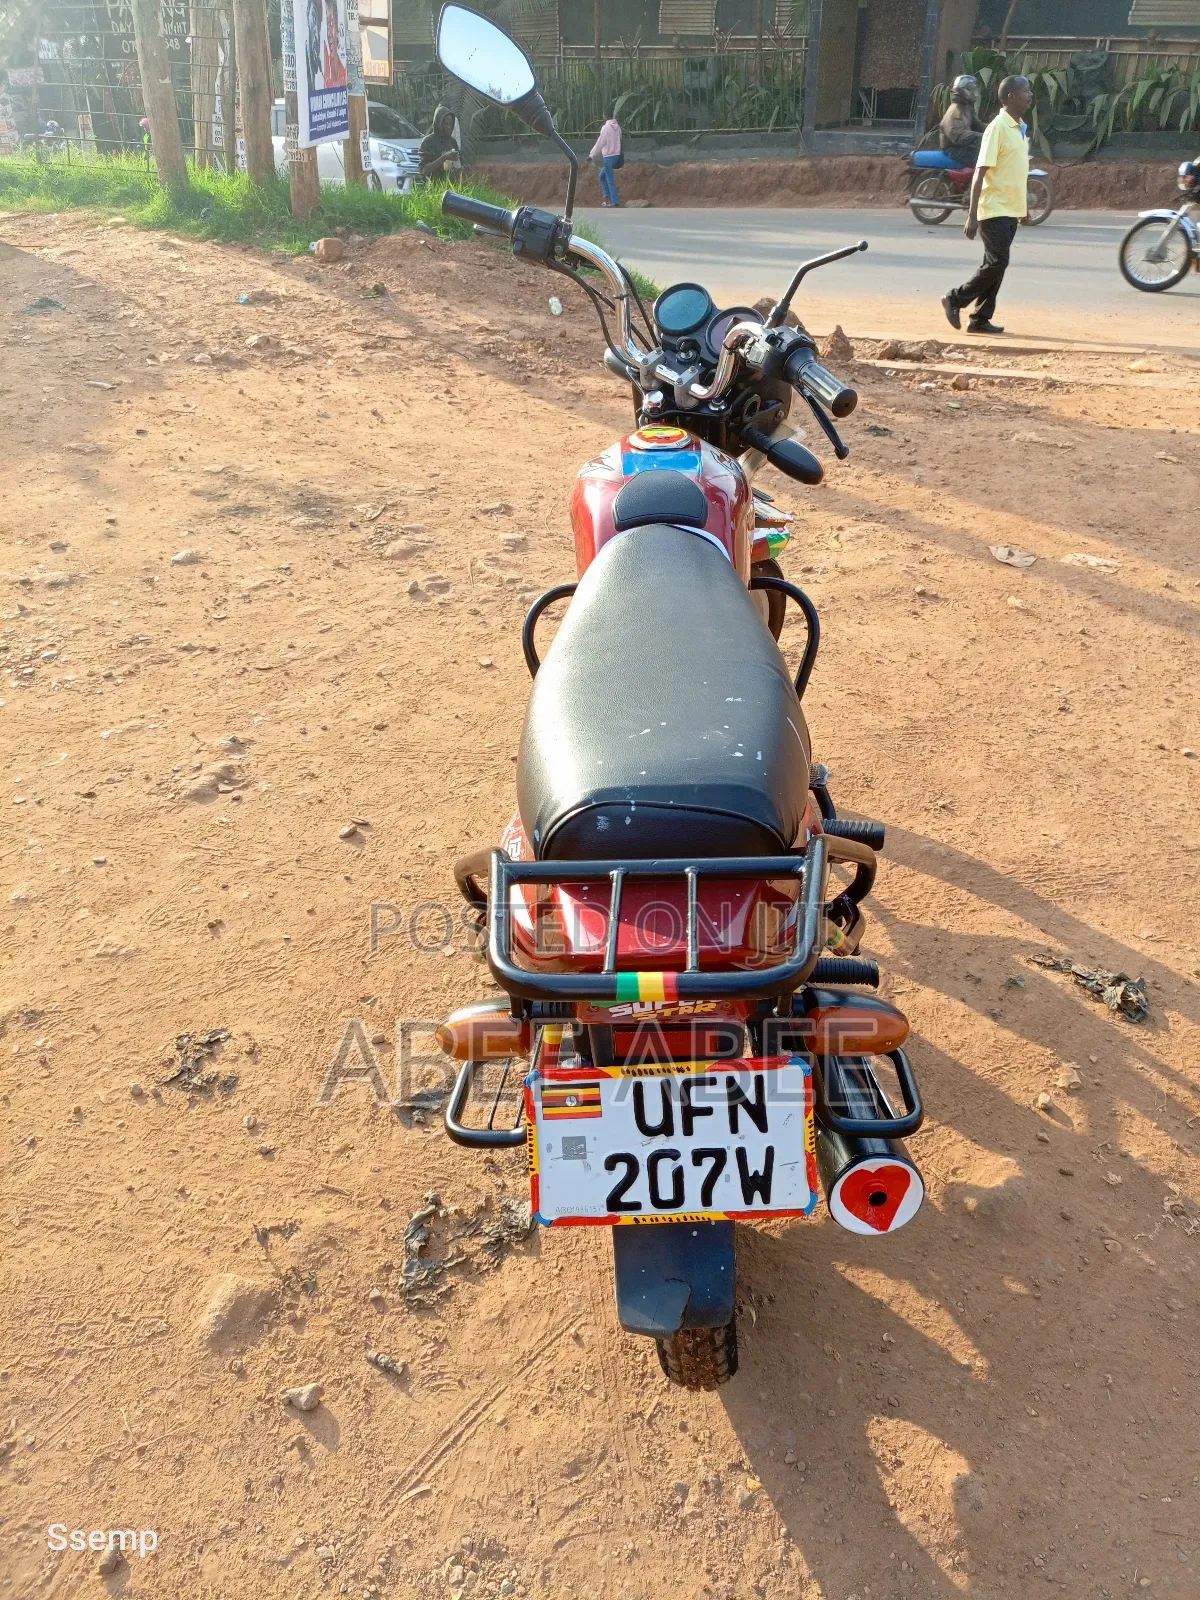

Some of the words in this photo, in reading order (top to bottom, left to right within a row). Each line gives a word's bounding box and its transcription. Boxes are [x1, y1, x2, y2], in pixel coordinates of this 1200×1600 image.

[111, 20, 133, 33] DAY
[632, 1003, 717, 1020] STAR
[633, 1075, 769, 1137] UFN
[604, 1146, 775, 1212] 207W
